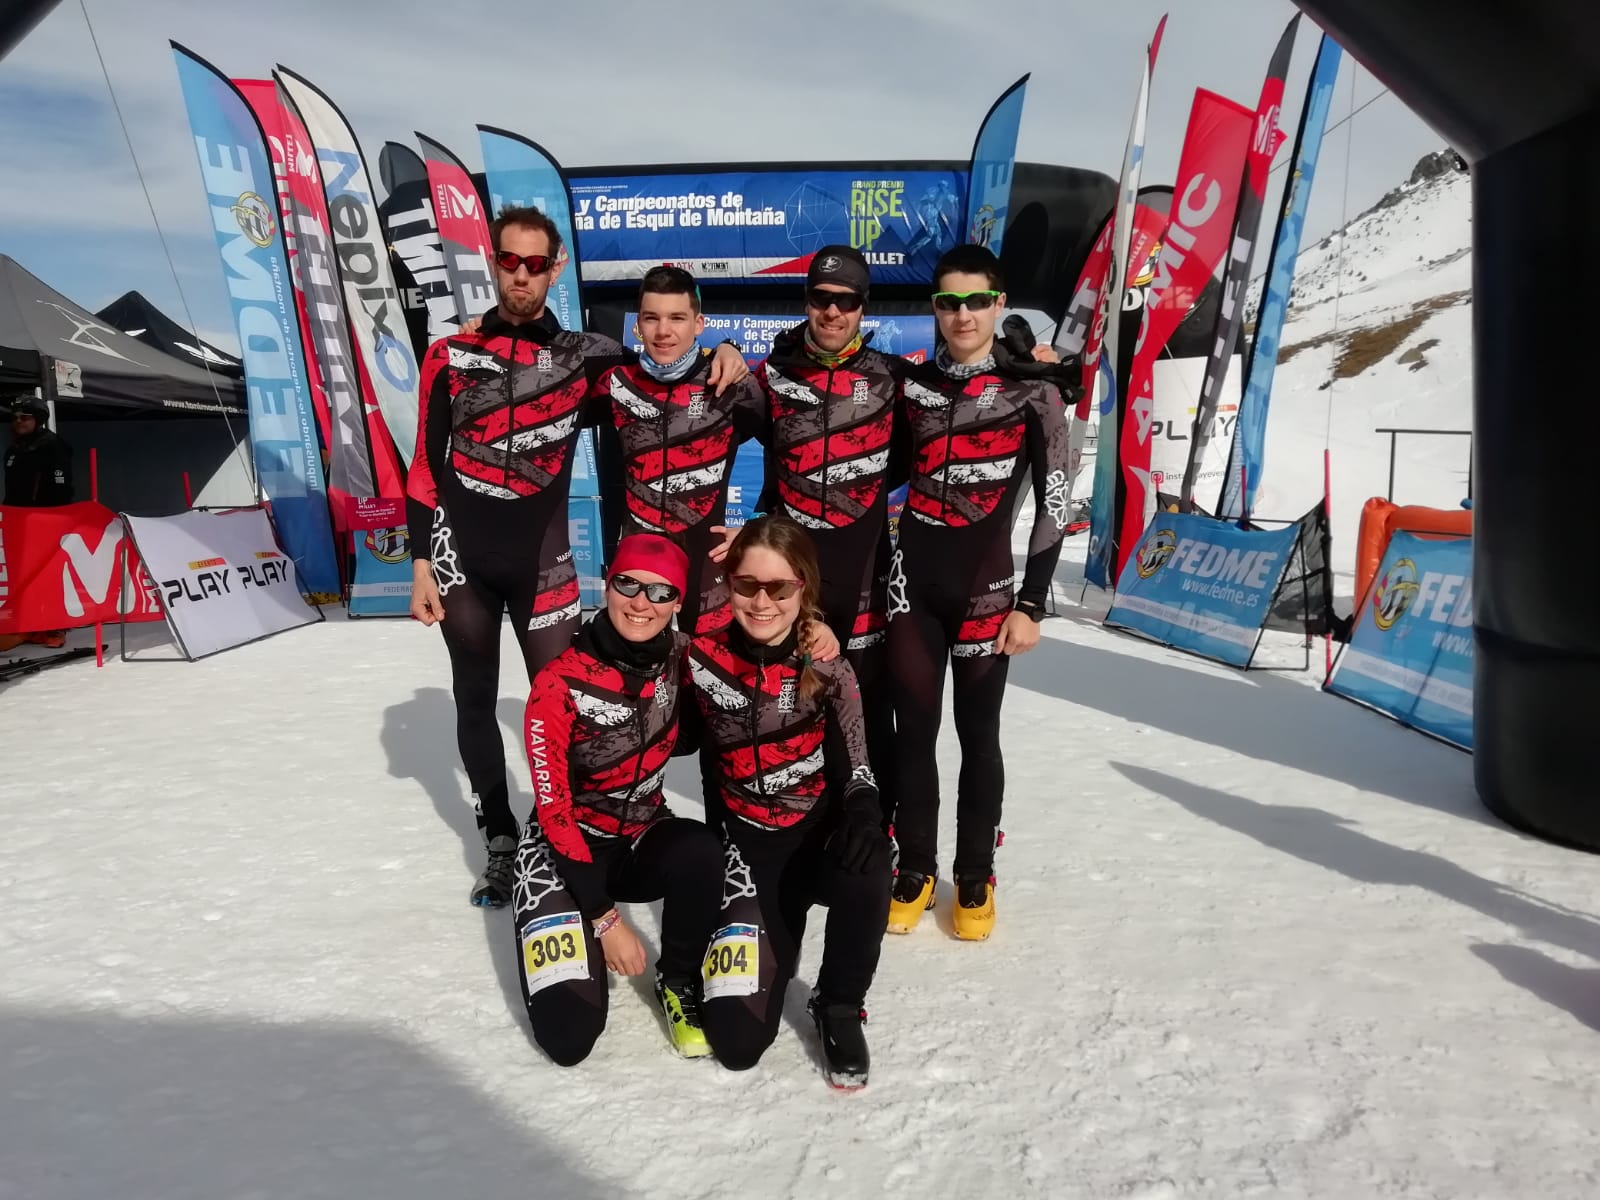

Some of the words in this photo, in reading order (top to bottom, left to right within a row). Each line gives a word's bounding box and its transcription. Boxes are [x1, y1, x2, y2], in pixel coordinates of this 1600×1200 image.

[595, 192, 716, 213] Campeonatos
[721, 192, 743, 208] de
[851, 188, 905, 217] RISE
[600, 212, 621, 229] de
[626, 208, 675, 232] Esquí
[680, 209, 702, 227] de
[707, 207, 785, 227] Montaña
[851, 219, 881, 250] UP
[862, 252, 906, 265] ILLET
[703, 317, 730, 330] Copa
[733, 319, 741, 330] y
[743, 317, 804, 331] Campeona
[744, 329, 758, 341] de
[752, 341, 767, 353] de
[1151, 414, 1237, 440] PLY
[1167, 537, 1278, 589] FEDME
[161, 569, 231, 608] PLAY
[236, 559, 288, 590] PLAY
[1182, 577, 1260, 608] www.fedme.es
[529, 718, 555, 806] NAVARRA
[531, 932, 576, 968] 303
[708, 945, 748, 977] 304
